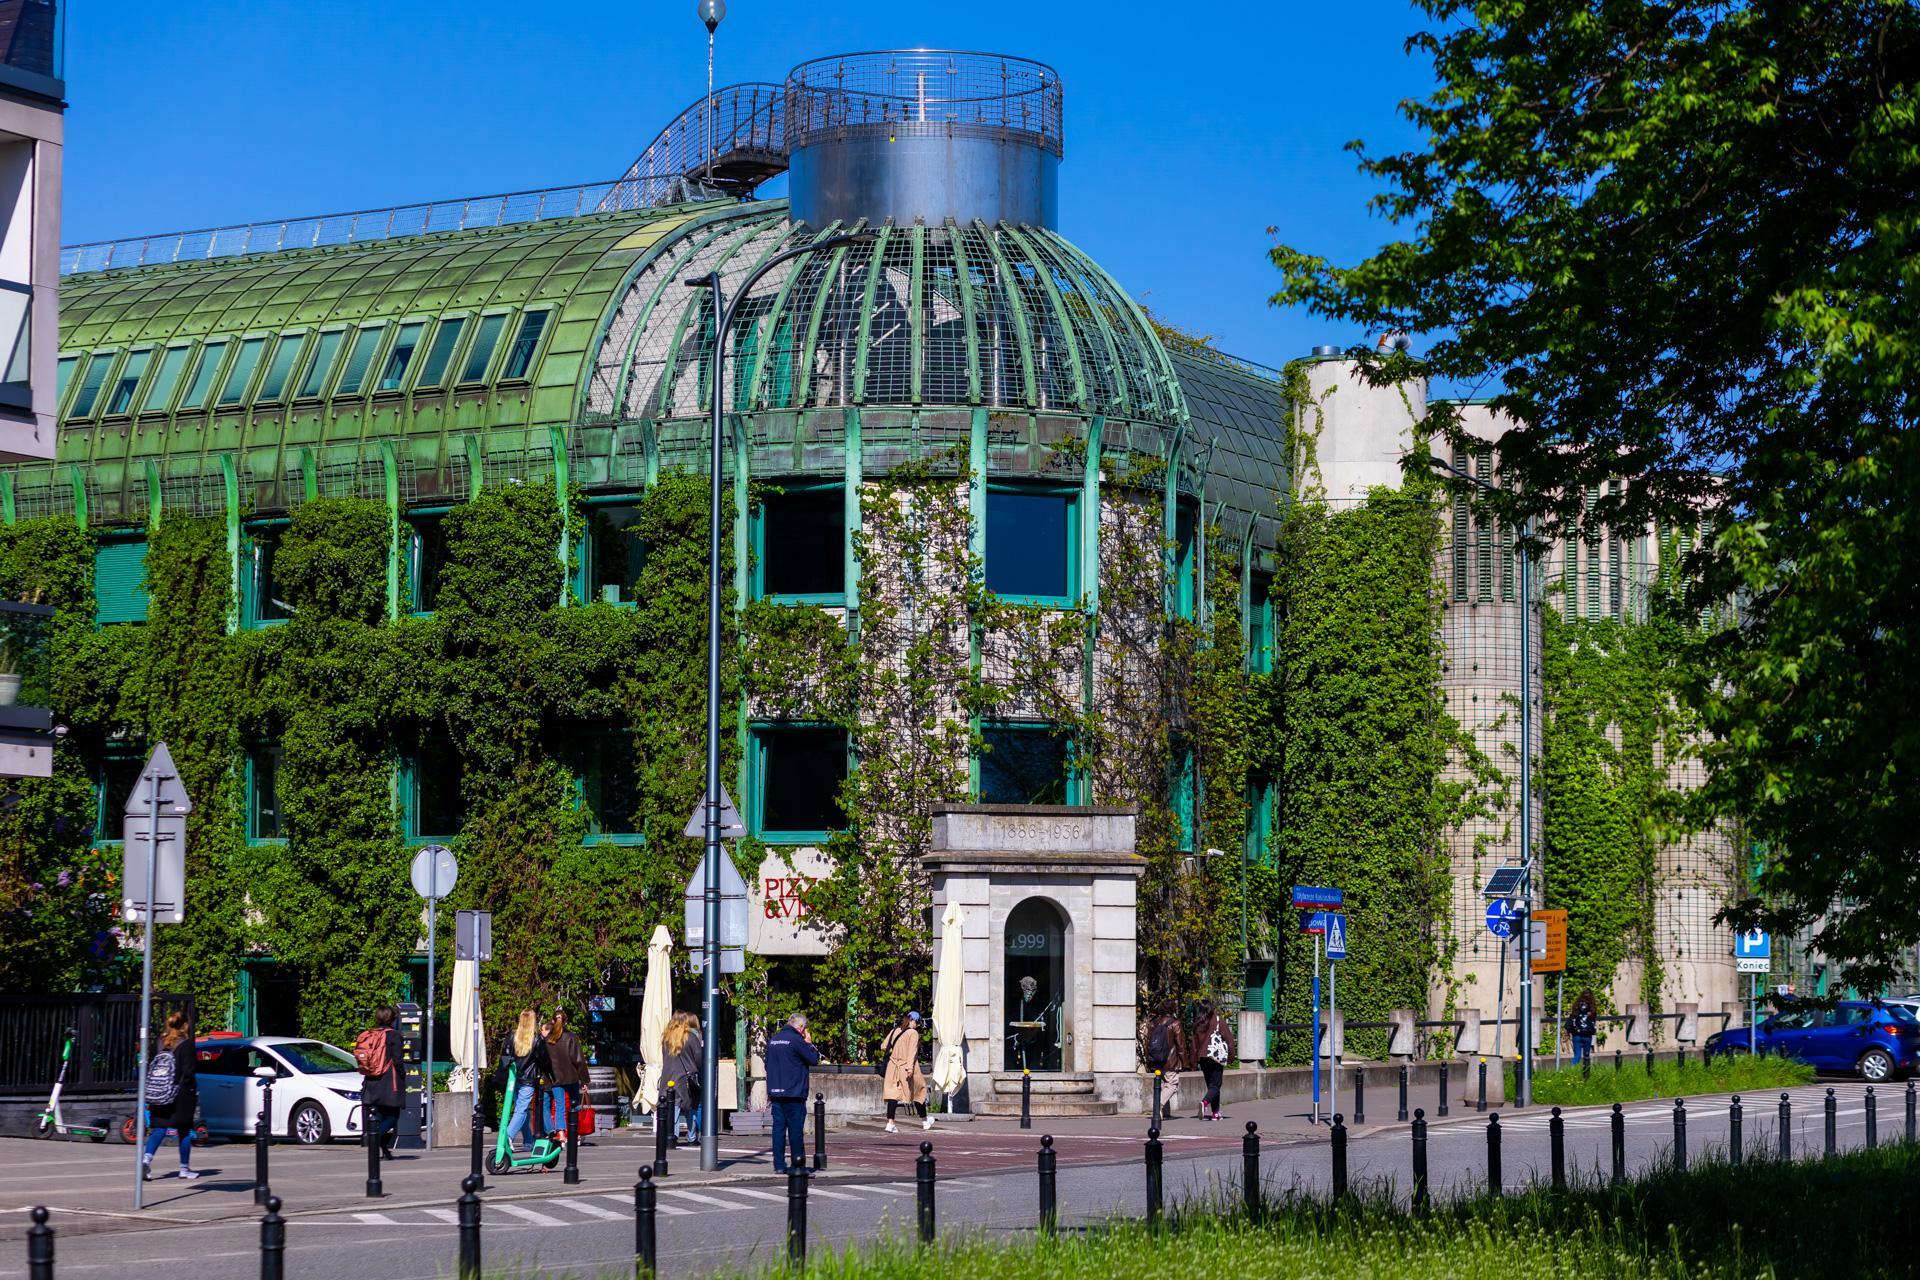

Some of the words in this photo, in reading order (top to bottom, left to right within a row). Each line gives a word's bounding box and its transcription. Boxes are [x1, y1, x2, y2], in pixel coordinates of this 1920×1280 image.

[1010, 934, 1045, 949] 1999
[1743, 927, 1763, 953] P
[1737, 960, 1769, 970] Koniec
